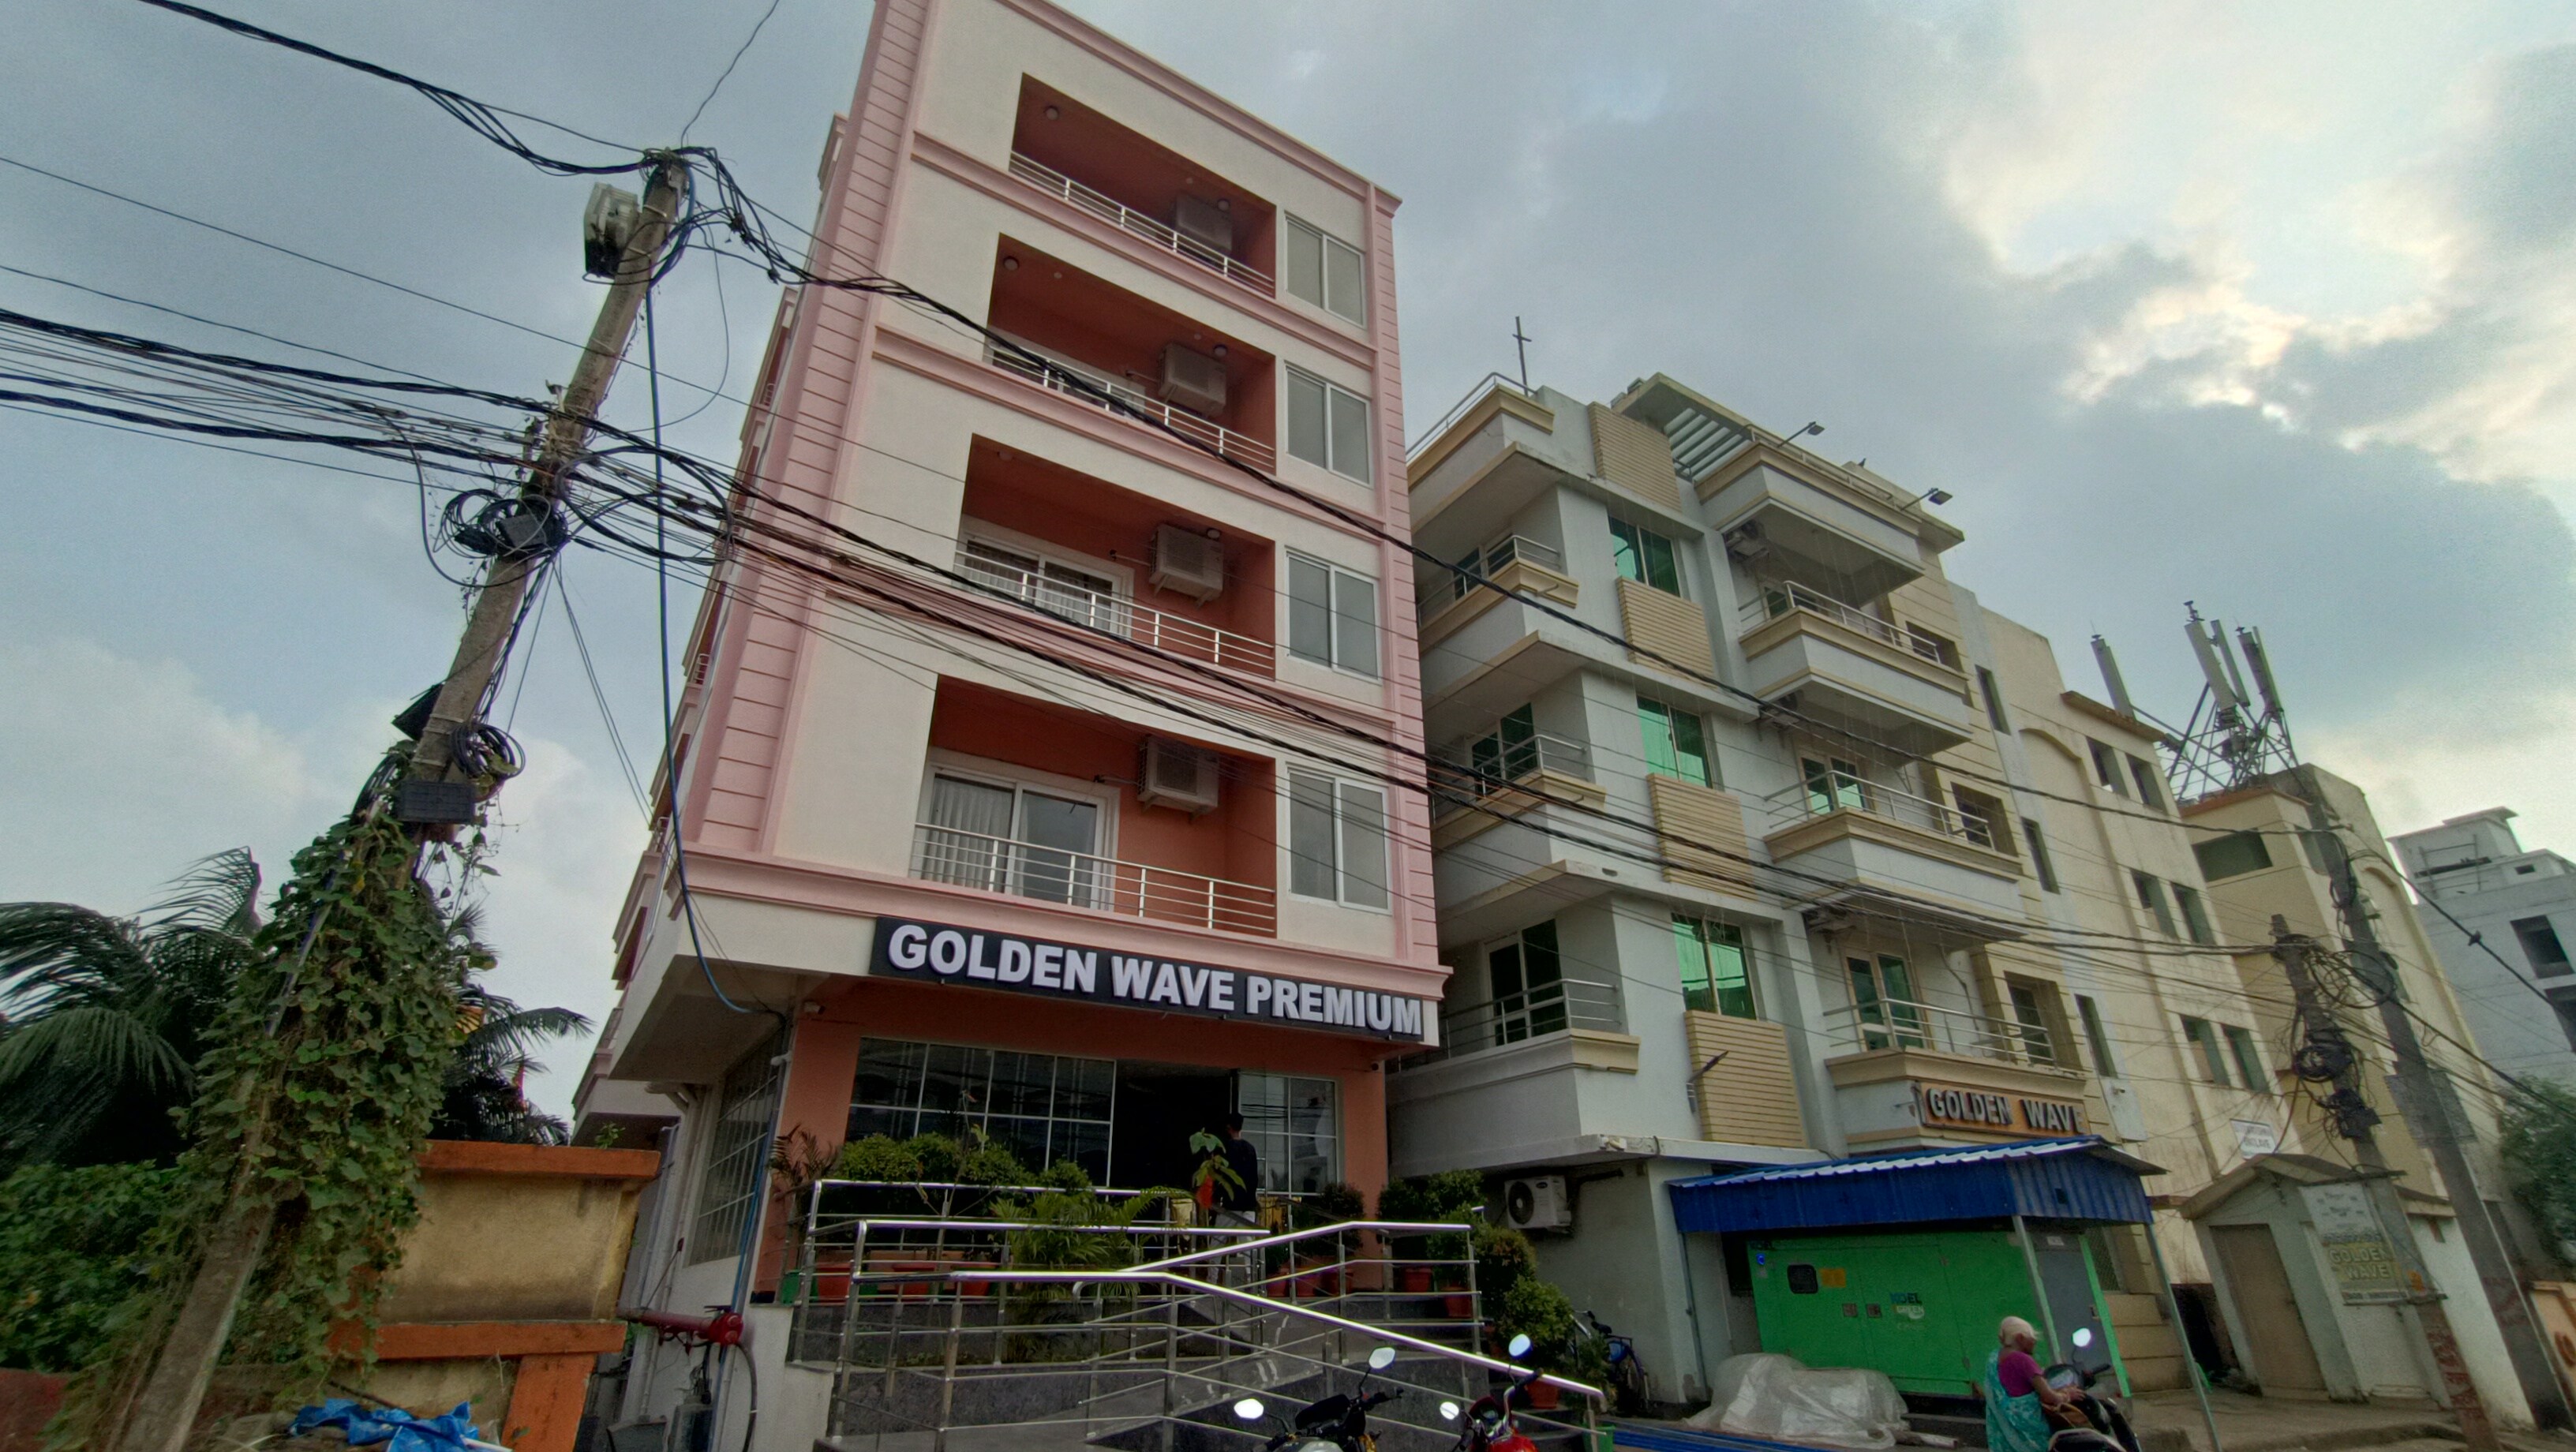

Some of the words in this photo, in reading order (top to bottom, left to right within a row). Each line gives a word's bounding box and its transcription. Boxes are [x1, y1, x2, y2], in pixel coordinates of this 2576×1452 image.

[889, 924, 1097, 993] GOLDEN
[1110, 955, 1235, 1011] WAVE
[1246, 977, 1421, 1035] PREMIUM
[1928, 1088, 2012, 1125] GOLDEN
[2020, 1099, 2088, 1134] WAVE
[2345, 1263, 2390, 1278] WAVE
